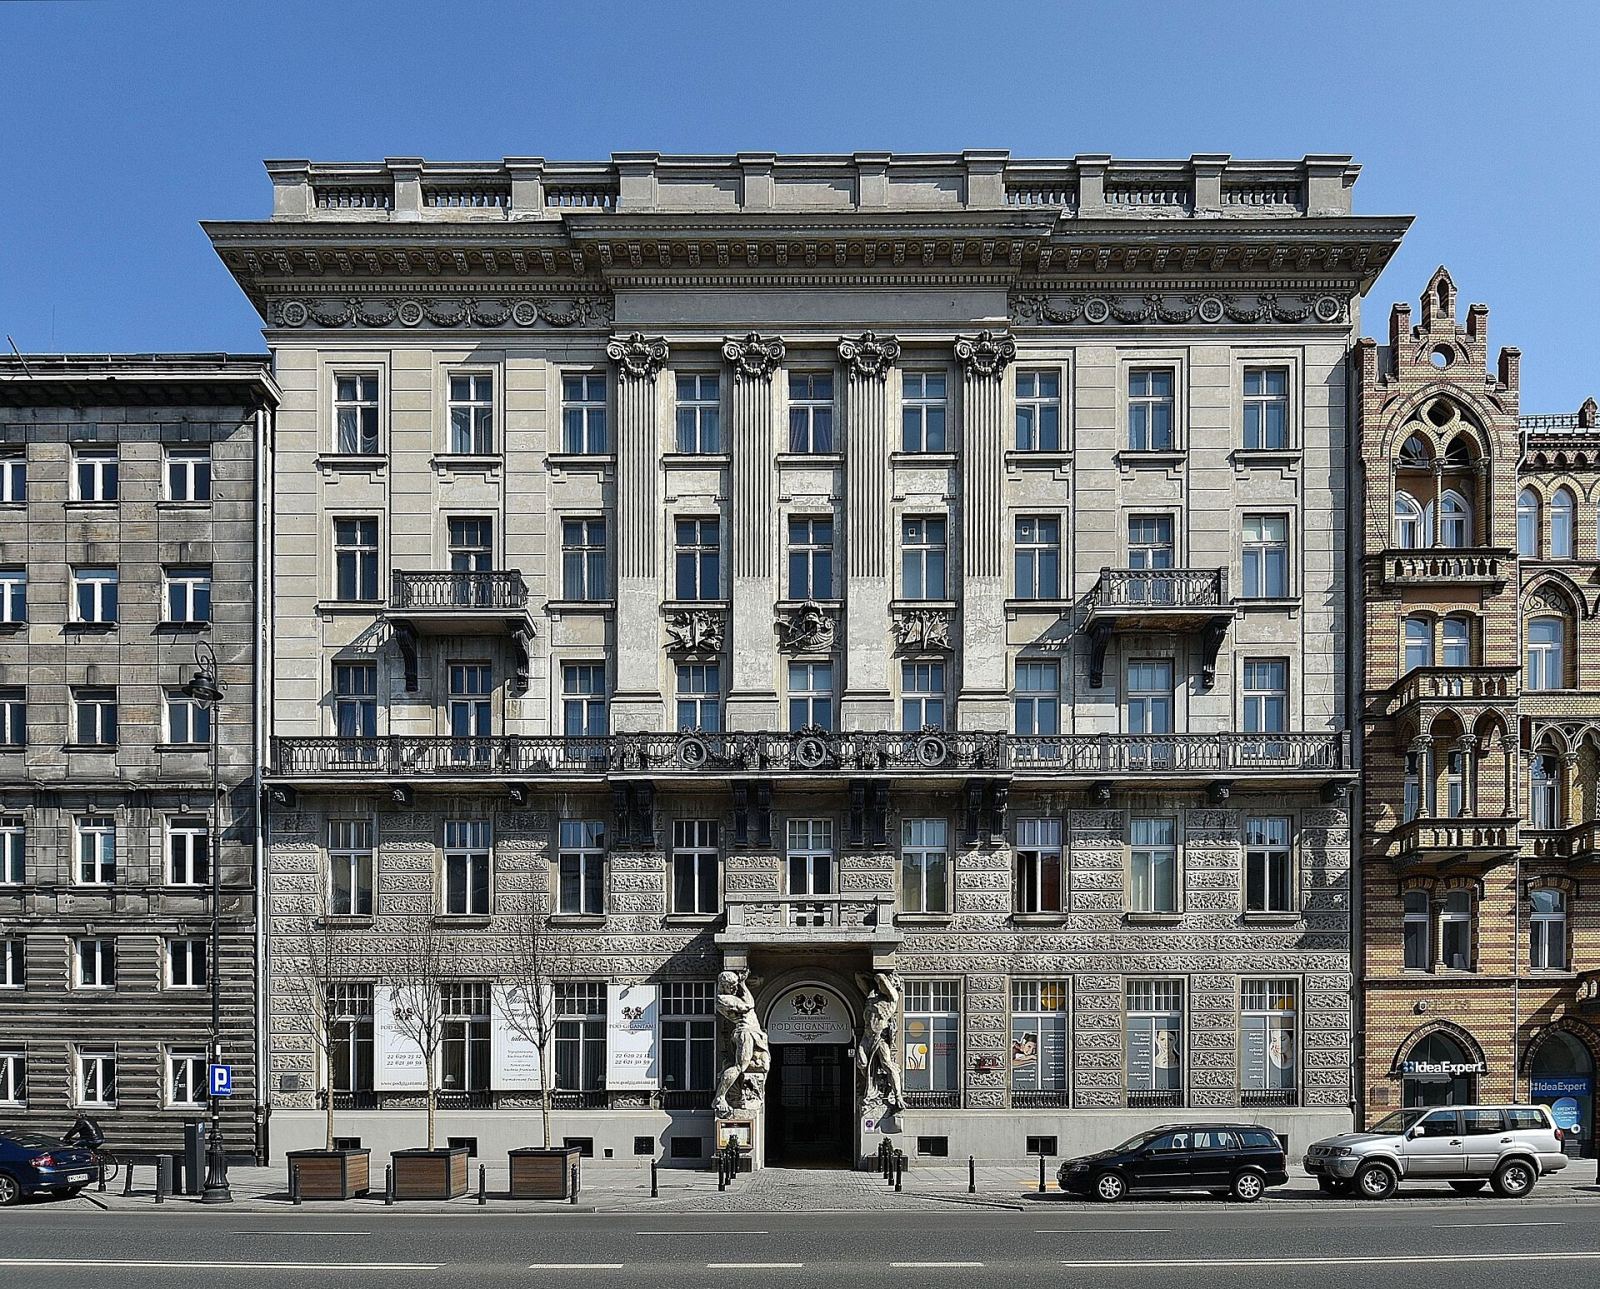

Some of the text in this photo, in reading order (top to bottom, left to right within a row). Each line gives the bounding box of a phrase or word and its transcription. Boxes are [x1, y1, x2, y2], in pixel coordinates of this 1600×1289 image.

[771, 1022, 849, 1031] POD GIGANTAMI
[1415, 1061, 1485, 1075] IdeaExpert
[214, 1067, 227, 1092] P
[1538, 1081, 1587, 1093] IdeaExpert
